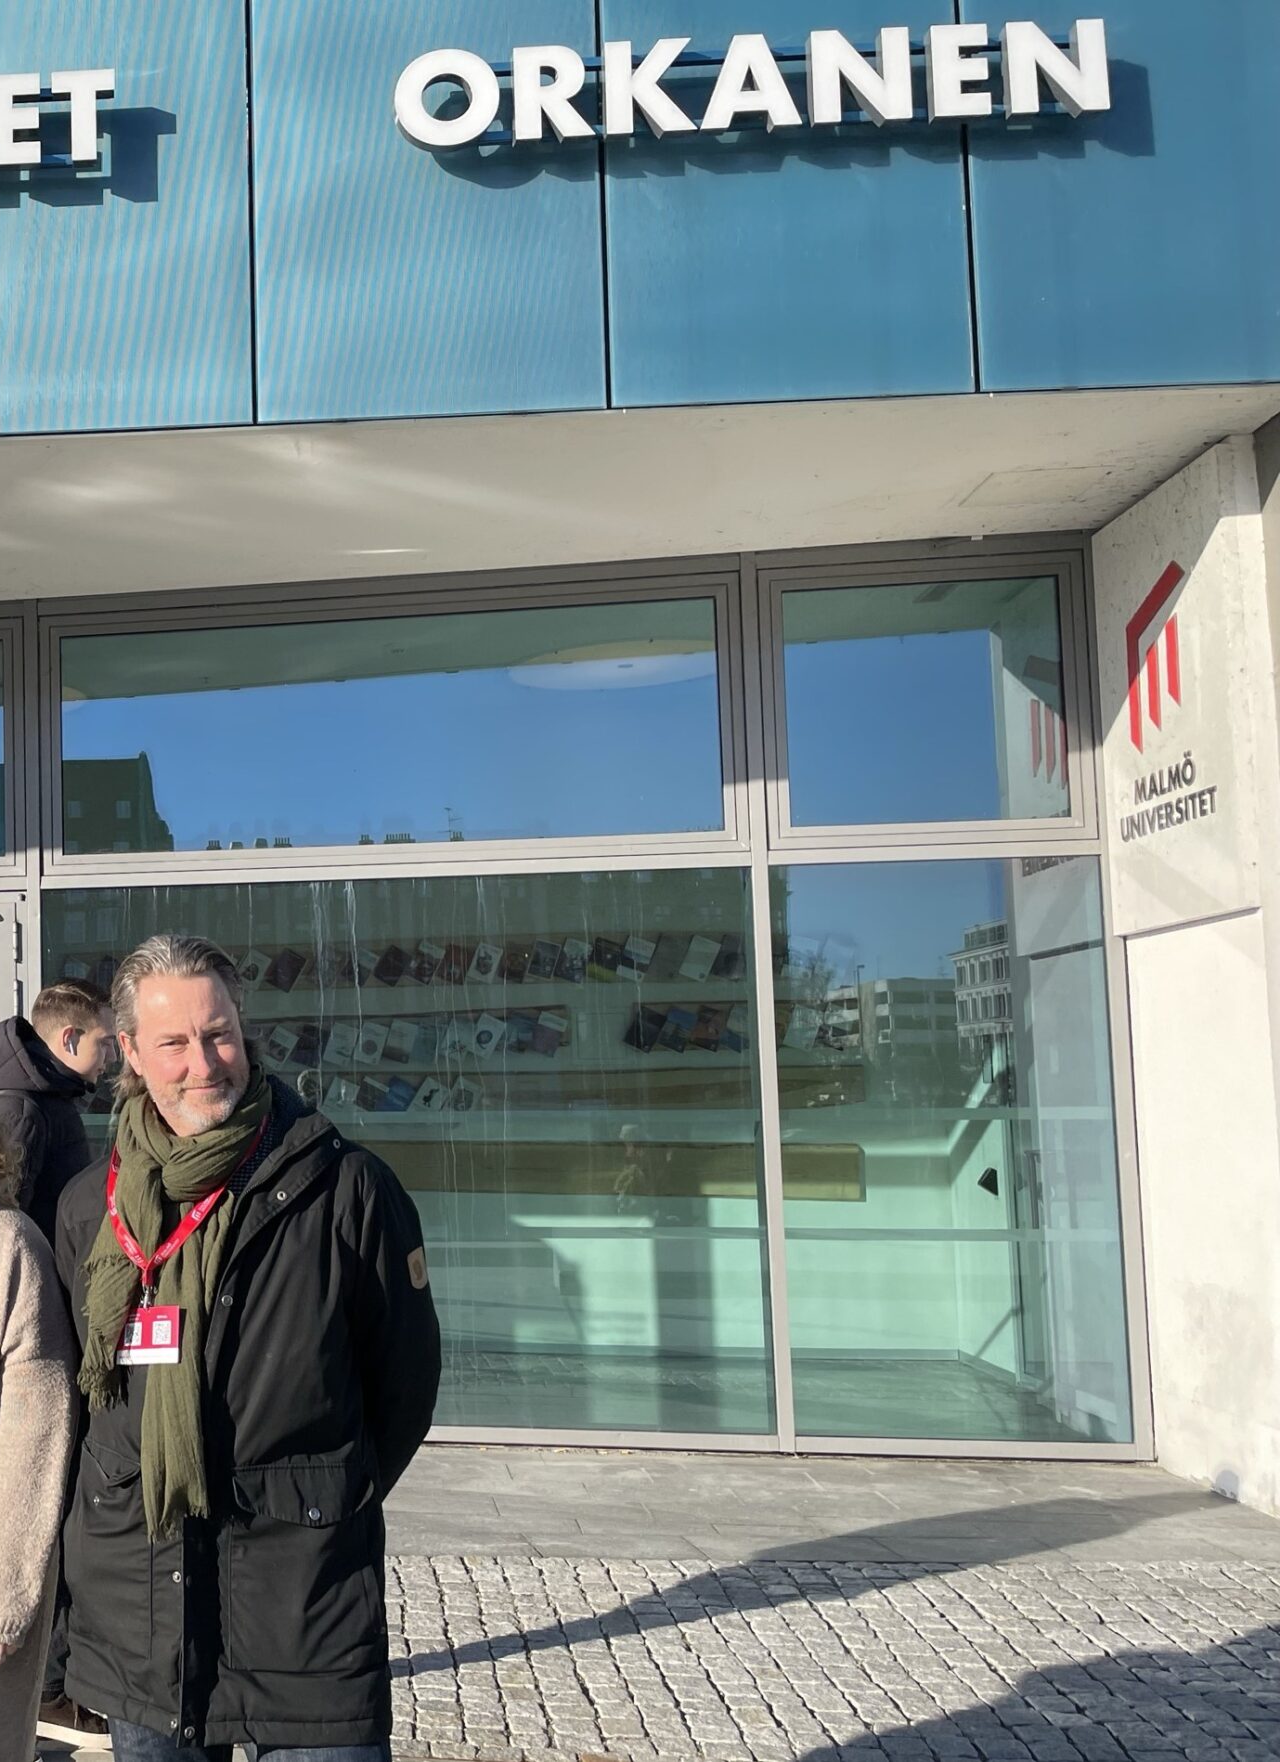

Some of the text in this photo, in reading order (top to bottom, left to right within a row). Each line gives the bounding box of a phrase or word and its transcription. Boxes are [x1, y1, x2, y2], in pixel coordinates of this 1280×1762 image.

[394, 18, 1111, 147] ORKANEN
[1134, 750, 1196, 806] MALMÖ
[1120, 785, 1217, 842] UNIVERSITET
